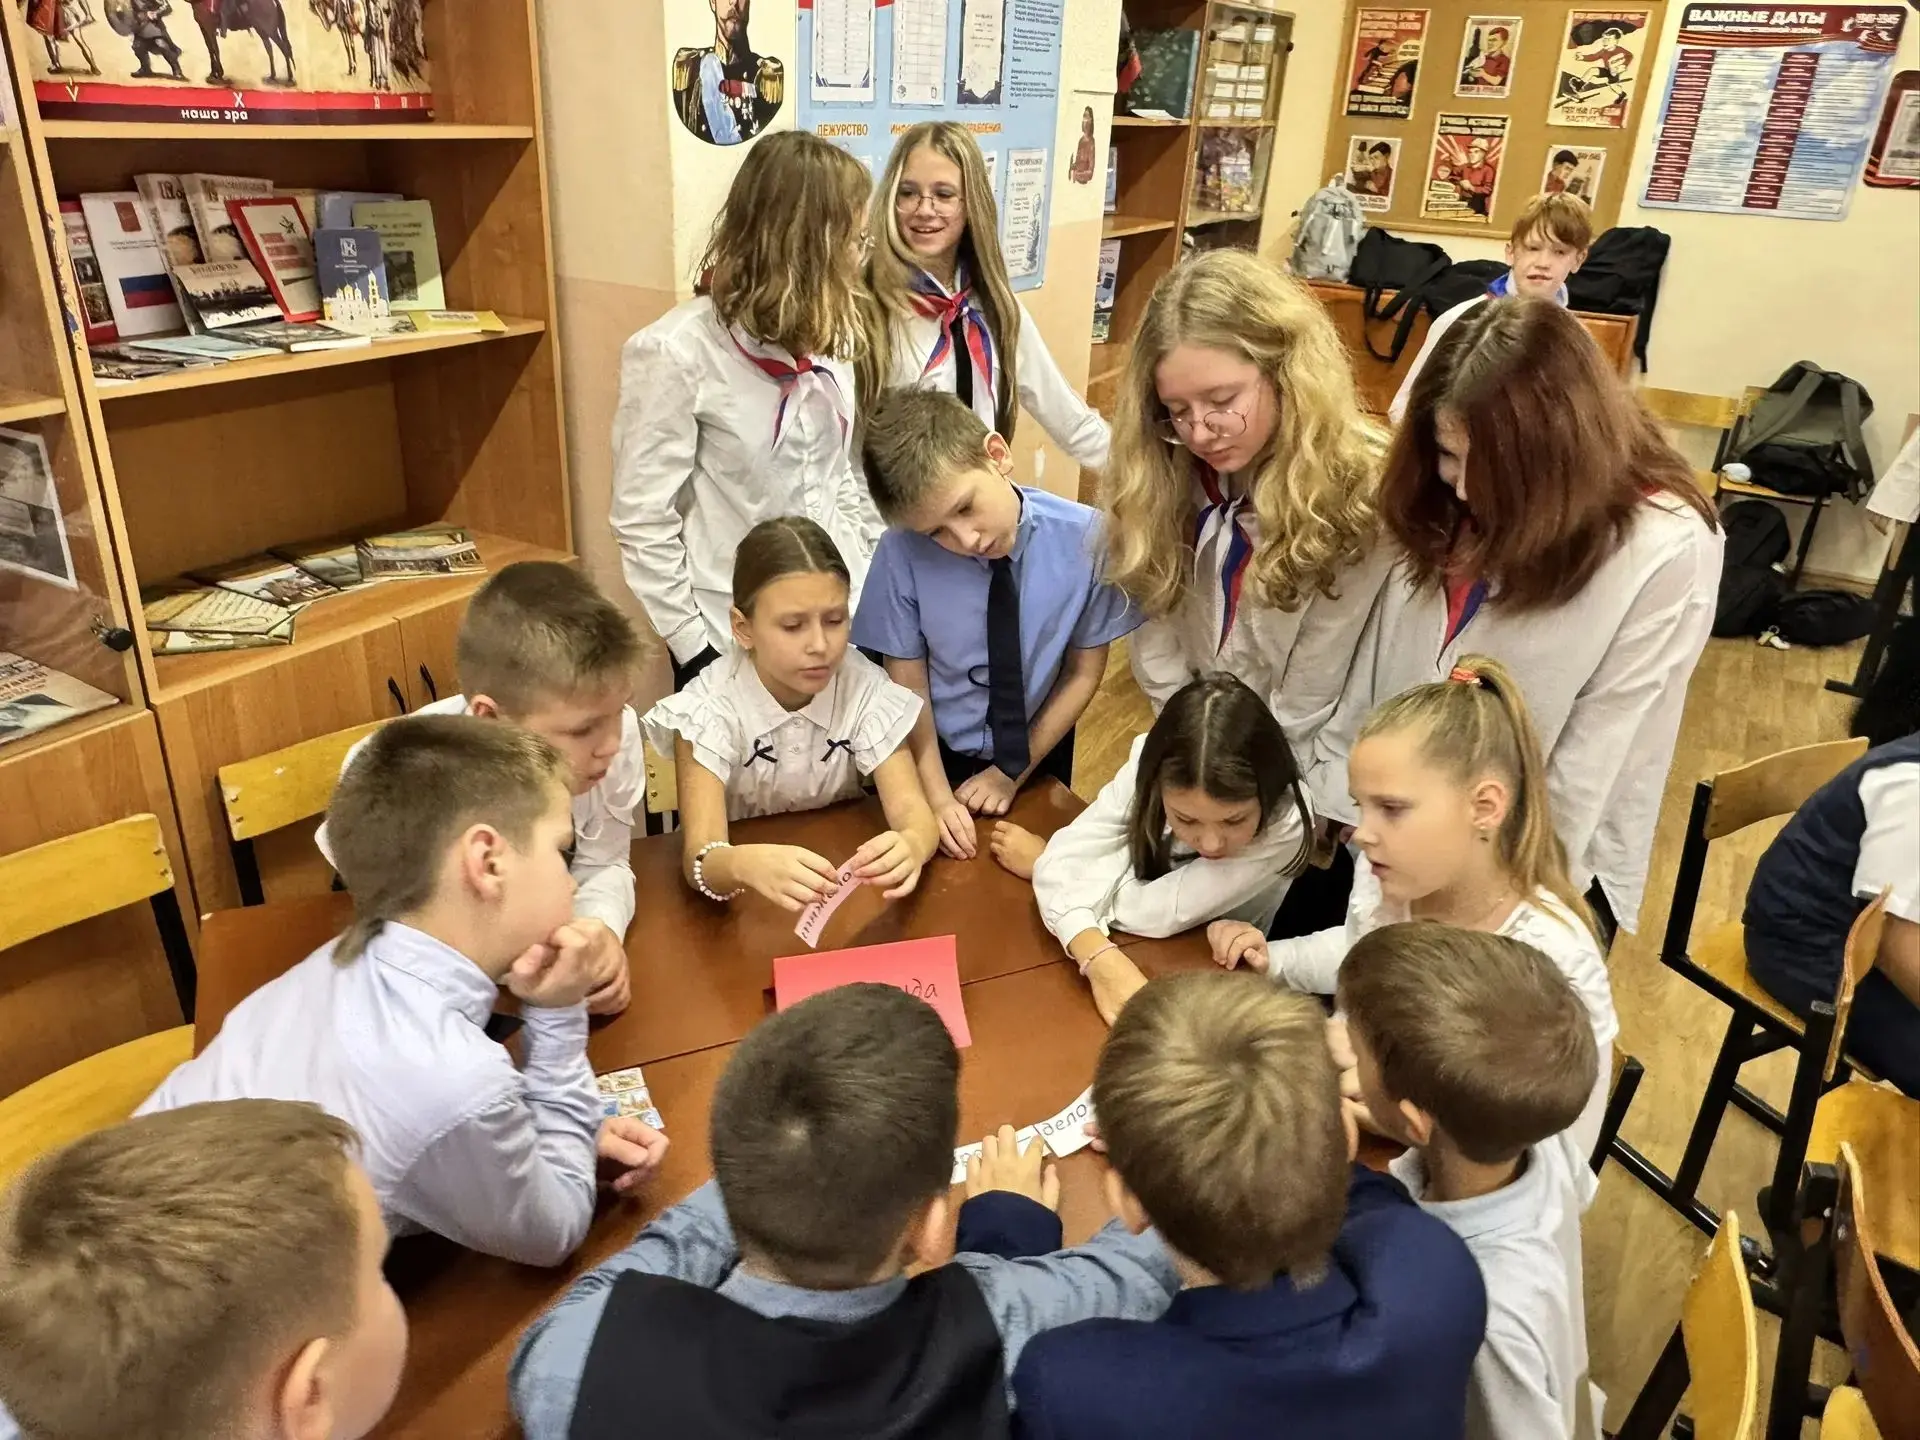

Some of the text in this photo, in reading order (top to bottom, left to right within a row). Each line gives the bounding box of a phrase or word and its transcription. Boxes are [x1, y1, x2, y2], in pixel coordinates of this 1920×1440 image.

[1688, 10, 1827, 25] ВАЖНЫЕ ДАТЫ
[181, 109, 248, 123] наша эра
[1042, 1103, 1088, 1137] дело
